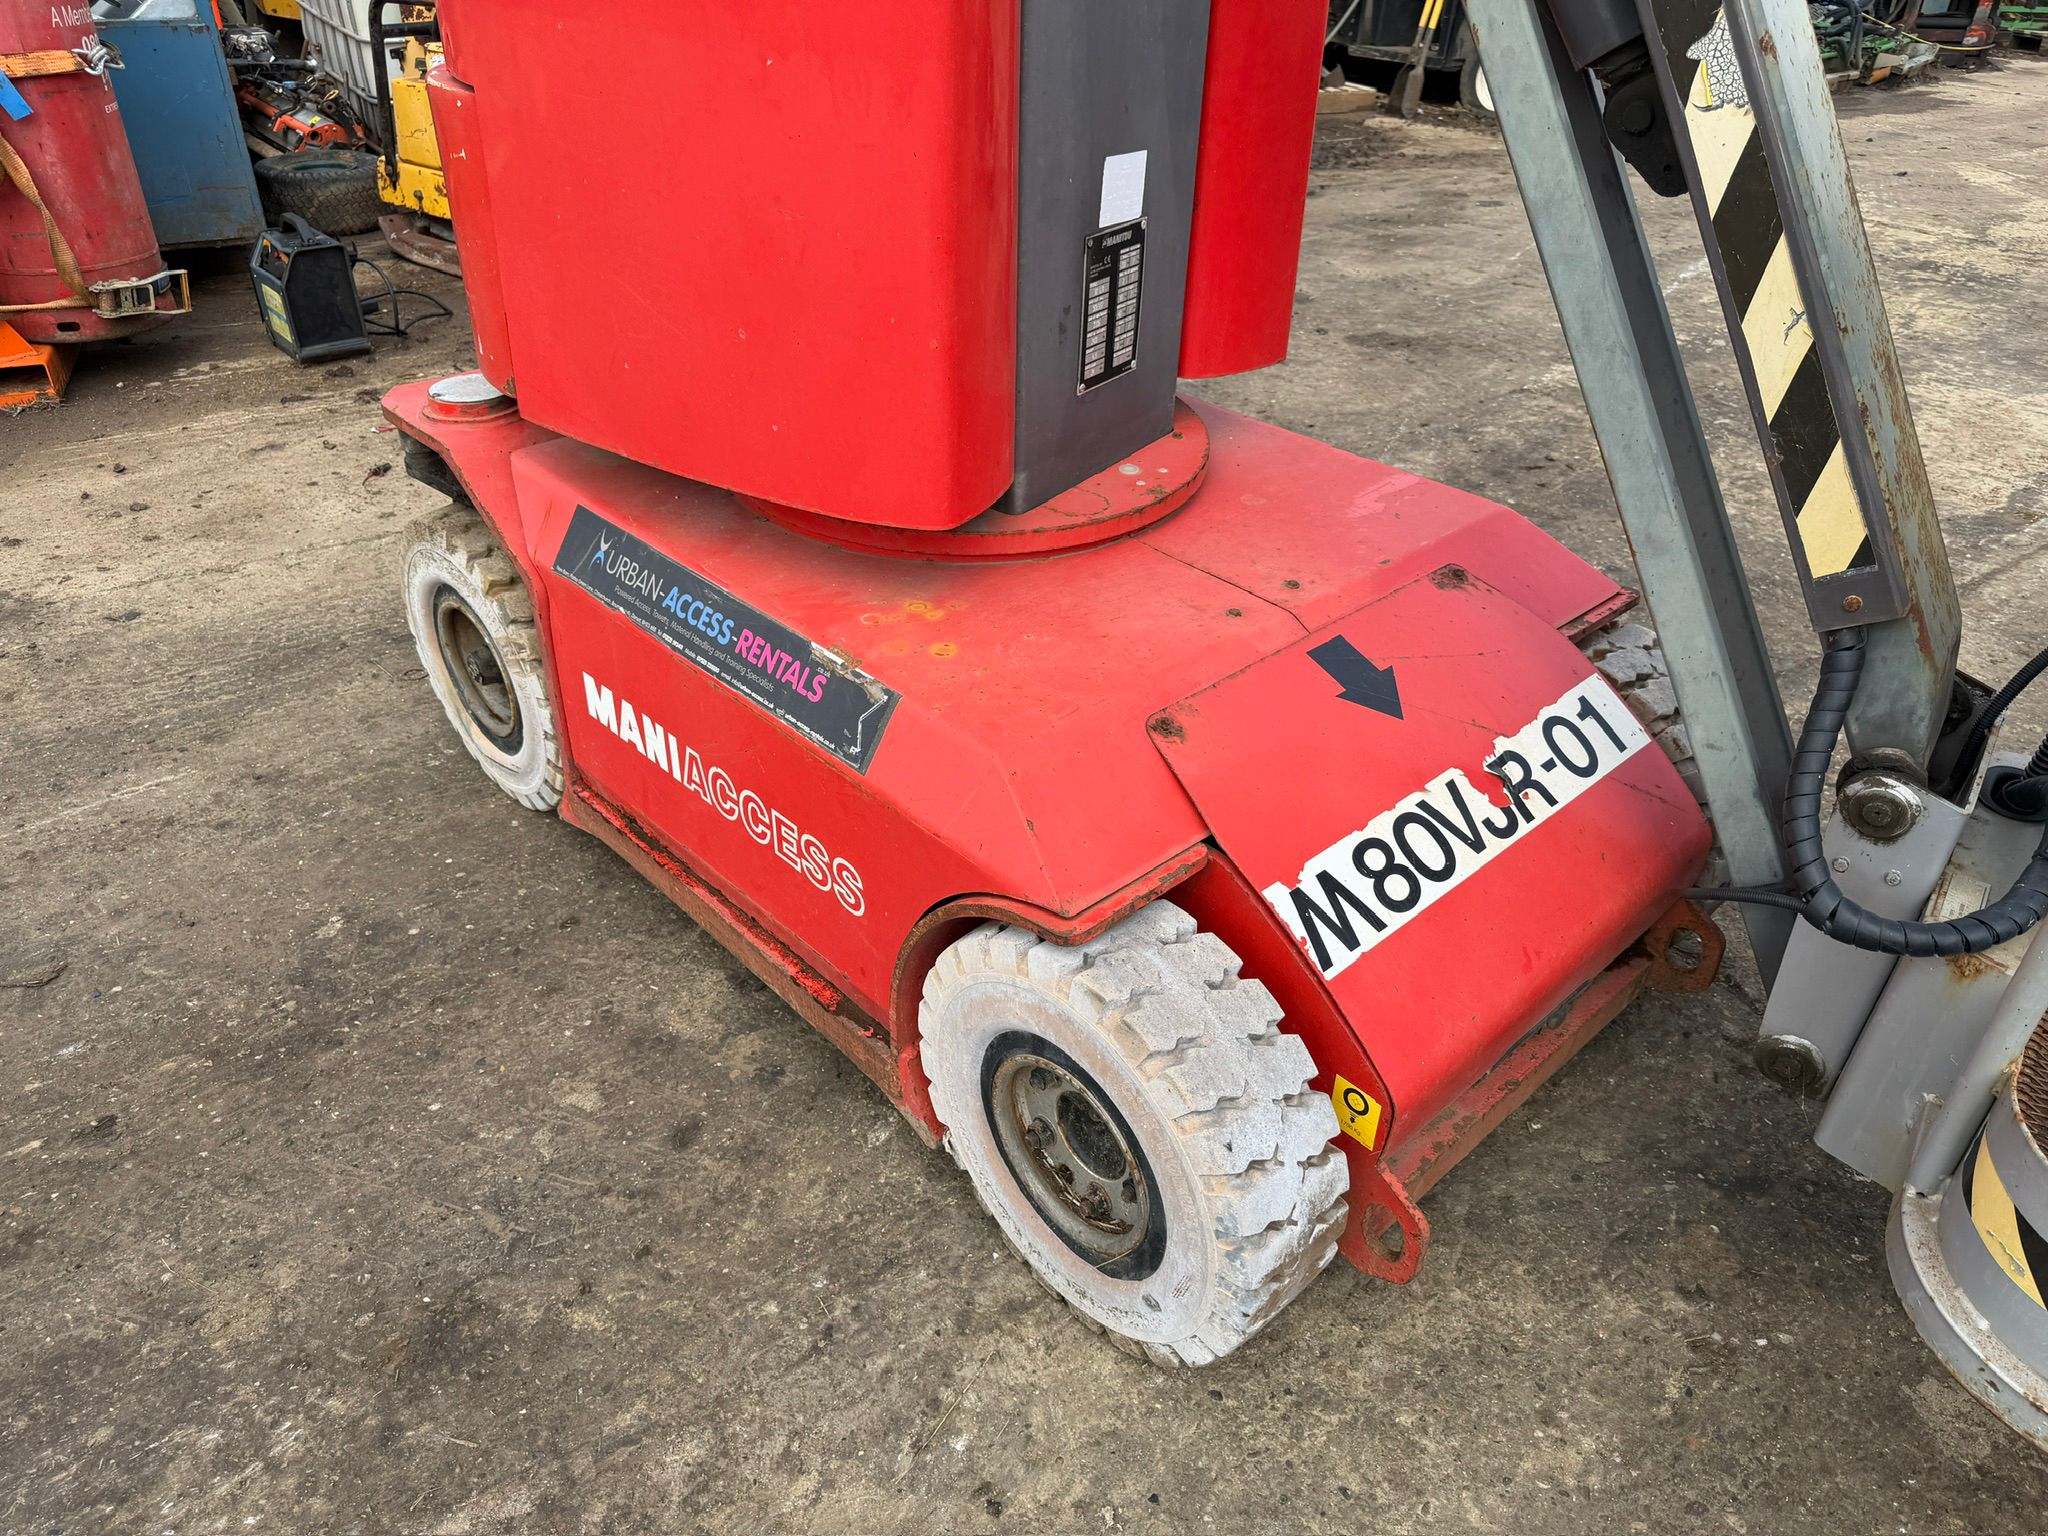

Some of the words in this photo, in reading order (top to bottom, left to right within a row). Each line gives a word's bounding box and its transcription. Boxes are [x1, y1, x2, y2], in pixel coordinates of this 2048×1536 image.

[51, 6, 63, 28] A
[614, 585, 635, 604] Powered
[634, 598, 651, 615] Access,
[670, 620, 692, 639] Material
[690, 633, 714, 655] Handling
[714, 650, 727, 661] and
[726, 655, 746, 676] Training
[746, 669, 774, 693] Specialists
